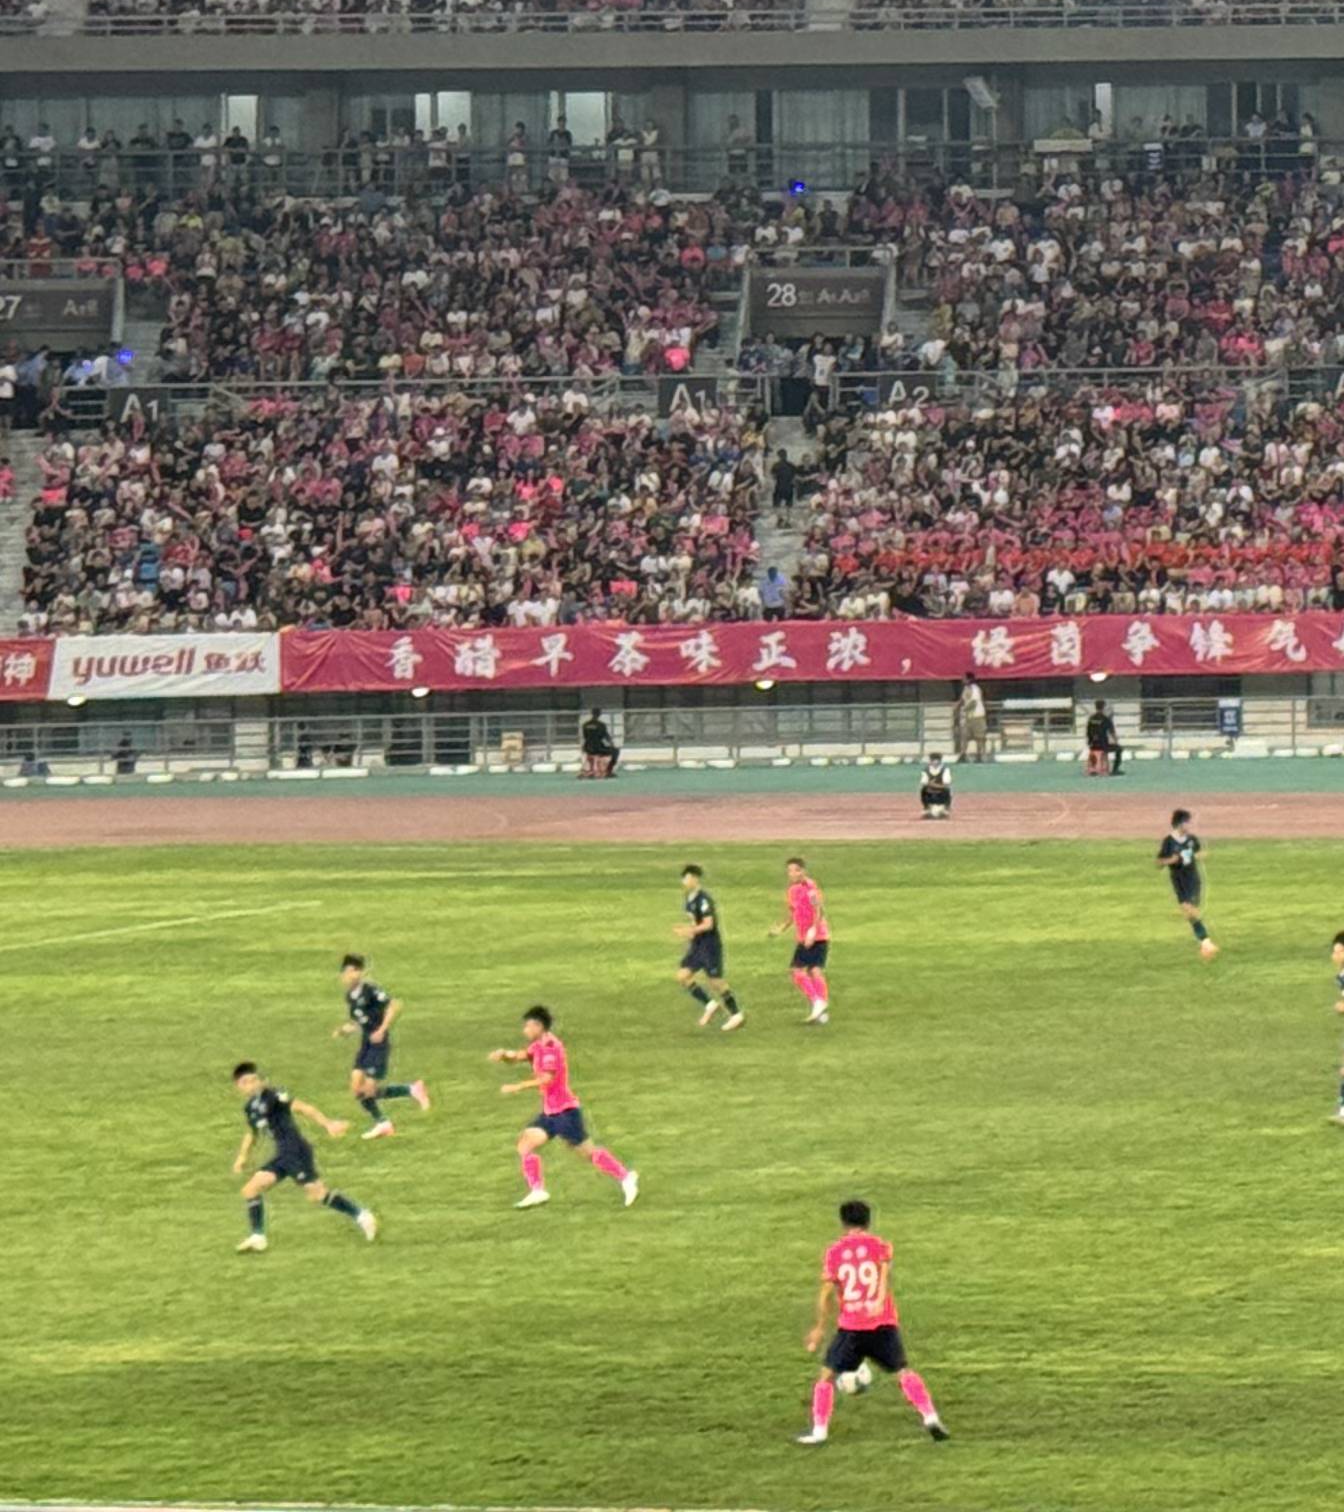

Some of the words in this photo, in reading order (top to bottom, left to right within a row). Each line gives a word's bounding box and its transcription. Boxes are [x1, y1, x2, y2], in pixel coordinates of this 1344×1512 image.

[767, 283, 797, 308] 28
[121, 393, 159, 421] A1
[670, 383, 706, 410] A1
[888, 380, 929, 409] A2
[72, 647, 196, 686] yuwell
[838, 1260, 879, 1302] 29
